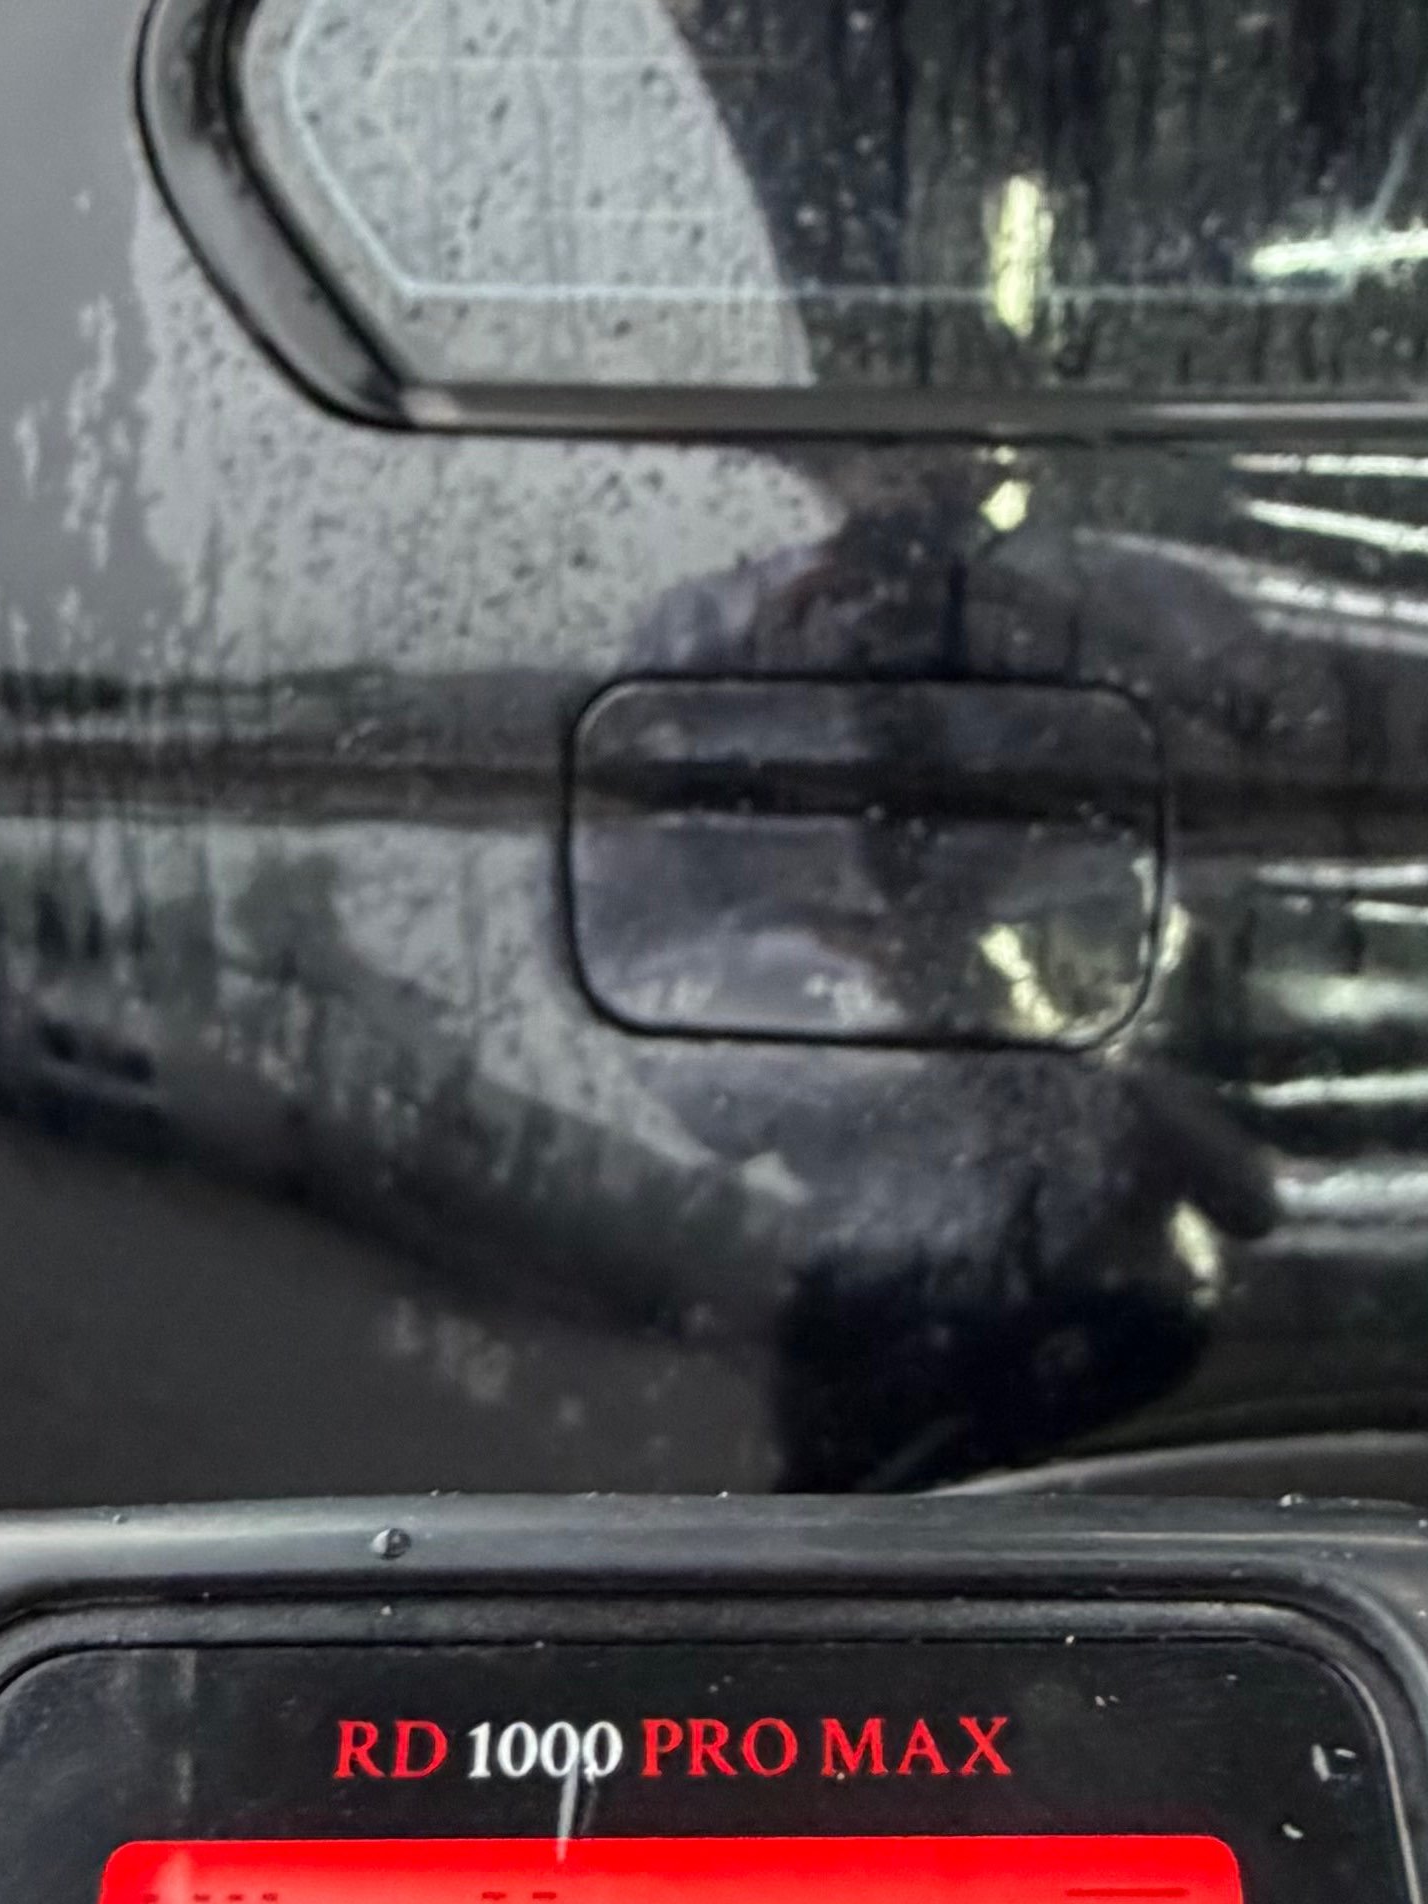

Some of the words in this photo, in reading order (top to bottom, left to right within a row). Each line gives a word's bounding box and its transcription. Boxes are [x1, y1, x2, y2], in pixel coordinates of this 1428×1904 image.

[333, 1718, 448, 1779] RD
[468, 1720, 624, 1781] 1000
[640, 1717, 800, 1778] PRO
[819, 1715, 1013, 1777] MAX
